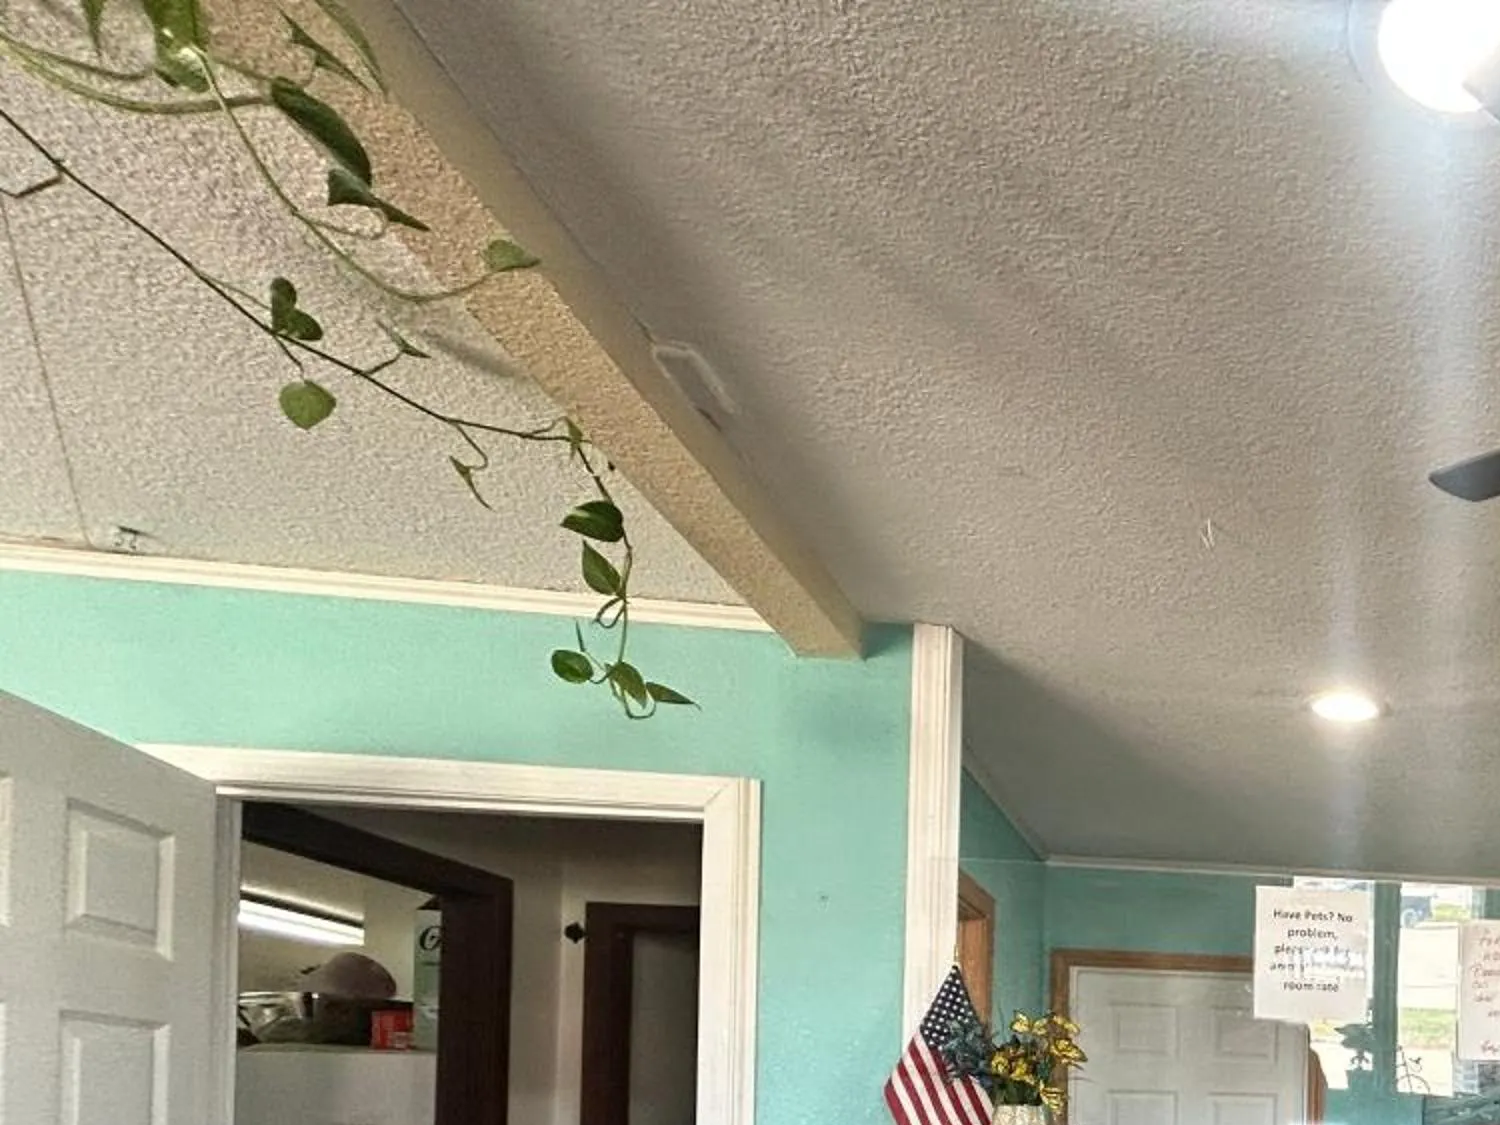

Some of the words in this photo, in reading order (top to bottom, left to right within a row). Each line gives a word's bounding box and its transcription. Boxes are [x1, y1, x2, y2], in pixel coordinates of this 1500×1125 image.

[1273, 908, 1301, 920] Have
[1304, 909, 1334, 921] Pets?
[1337, 912, 1353, 923] No
[1287, 928, 1337, 941] problem,
